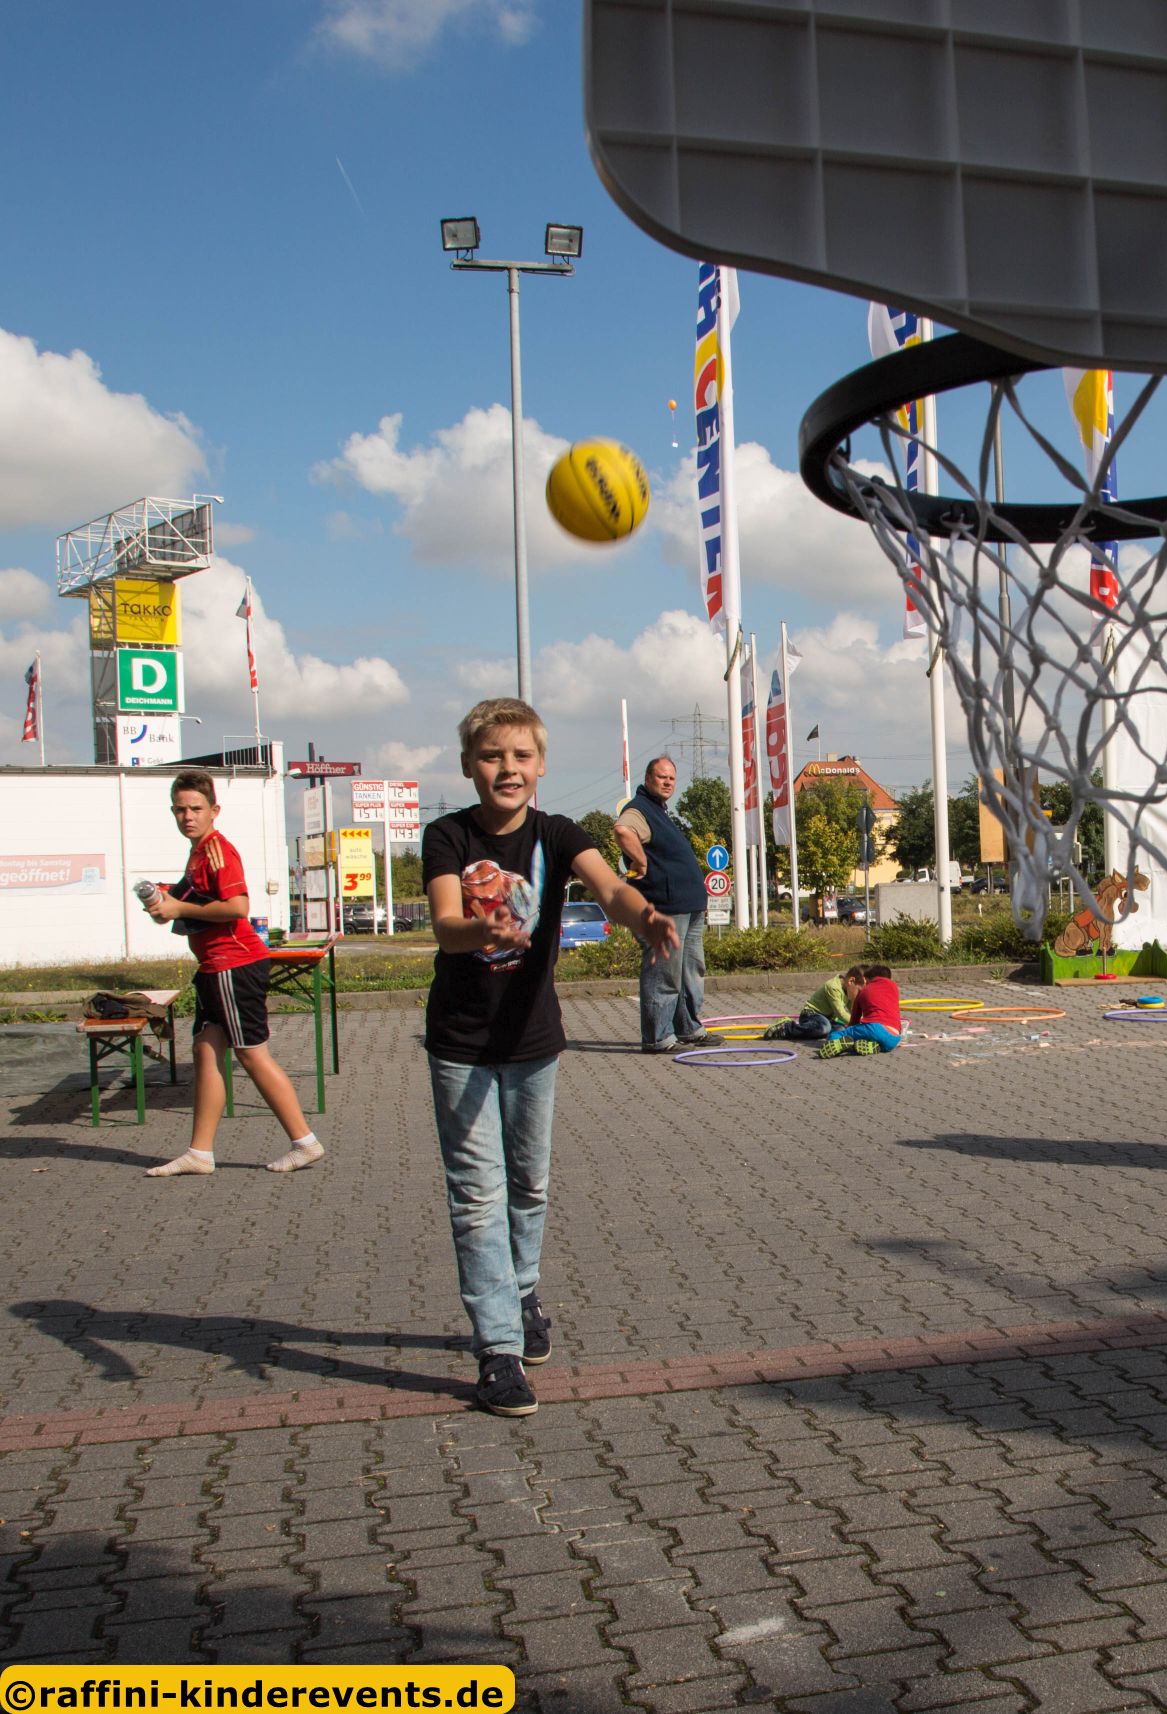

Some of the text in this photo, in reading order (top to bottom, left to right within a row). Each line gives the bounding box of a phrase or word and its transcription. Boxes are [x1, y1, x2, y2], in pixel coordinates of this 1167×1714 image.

[131, 658, 168, 694] D
[125, 697, 173, 705] DEICHMANN
[123, 726, 175, 743] BB Bank
[305, 762, 347, 774] Höffner
[353, 783, 384, 791] GÜNSTIG
[355, 792, 382, 800] TANKEN
[0, 868, 70, 885] geöffnet!
[711, 878, 726, 890] 20
